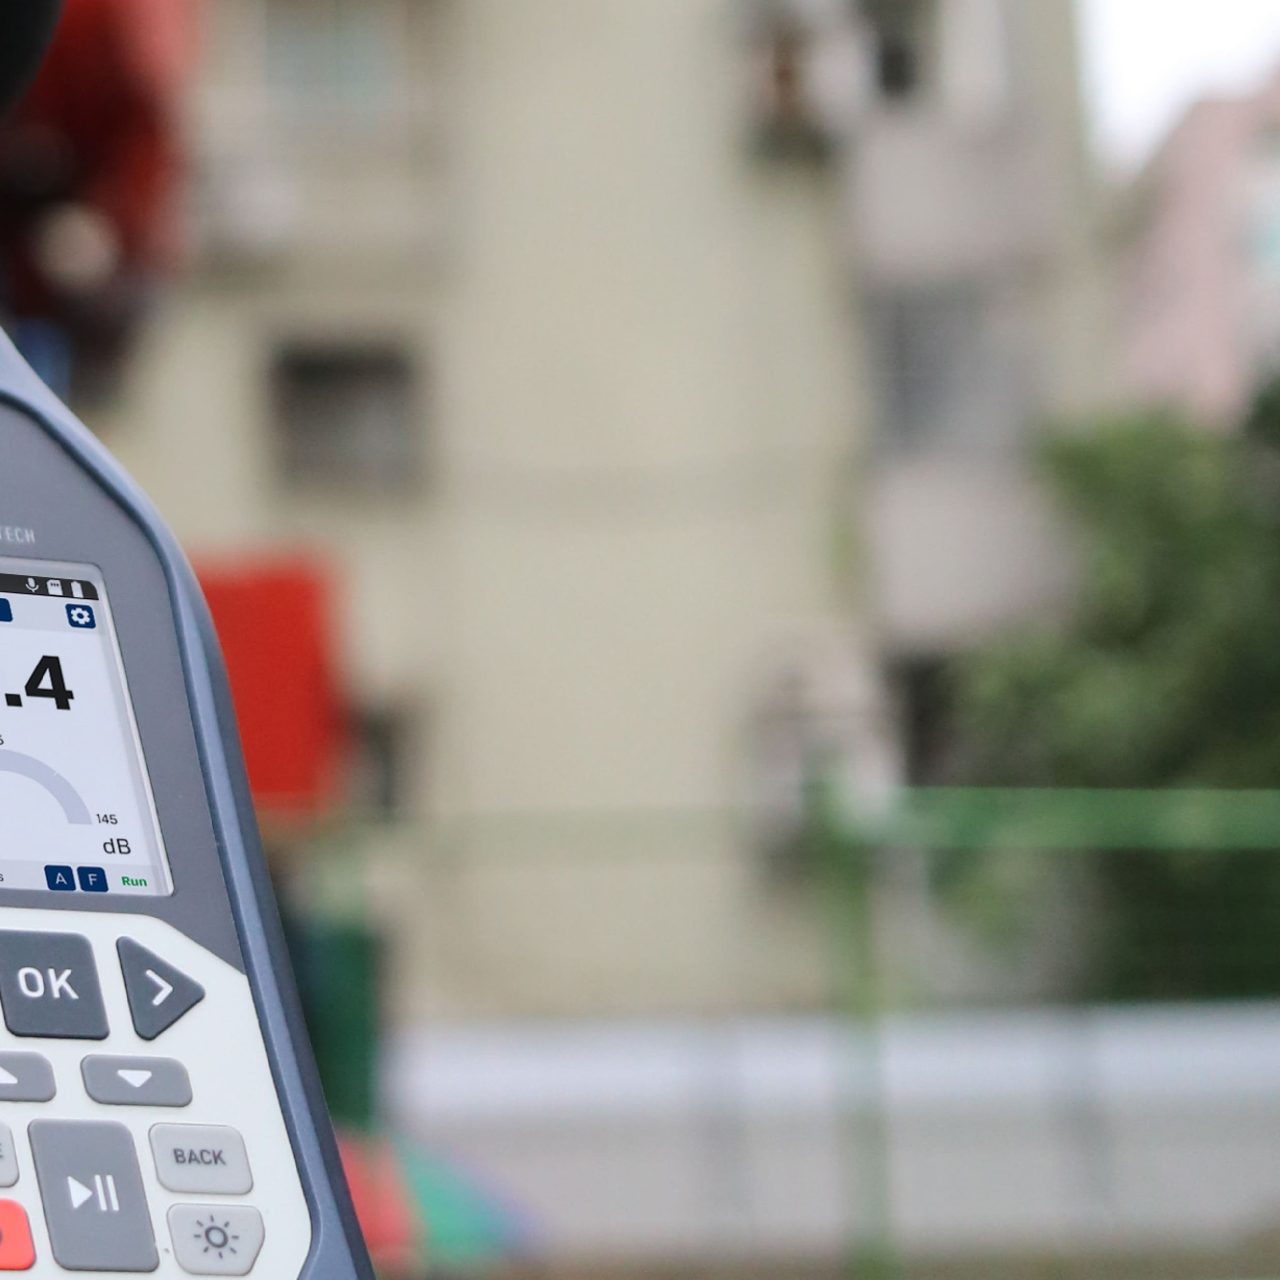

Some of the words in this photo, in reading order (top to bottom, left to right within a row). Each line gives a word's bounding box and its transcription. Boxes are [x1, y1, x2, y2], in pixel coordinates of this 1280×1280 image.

[96, 813, 118, 825] 145
[102, 837, 132, 855] dB
[54, 872, 68, 886] A
[87, 873, 99, 886] F
[120, 874, 148, 887] Run
[18, 967, 79, 1000] OK
[173, 1147, 226, 1166] BACK
